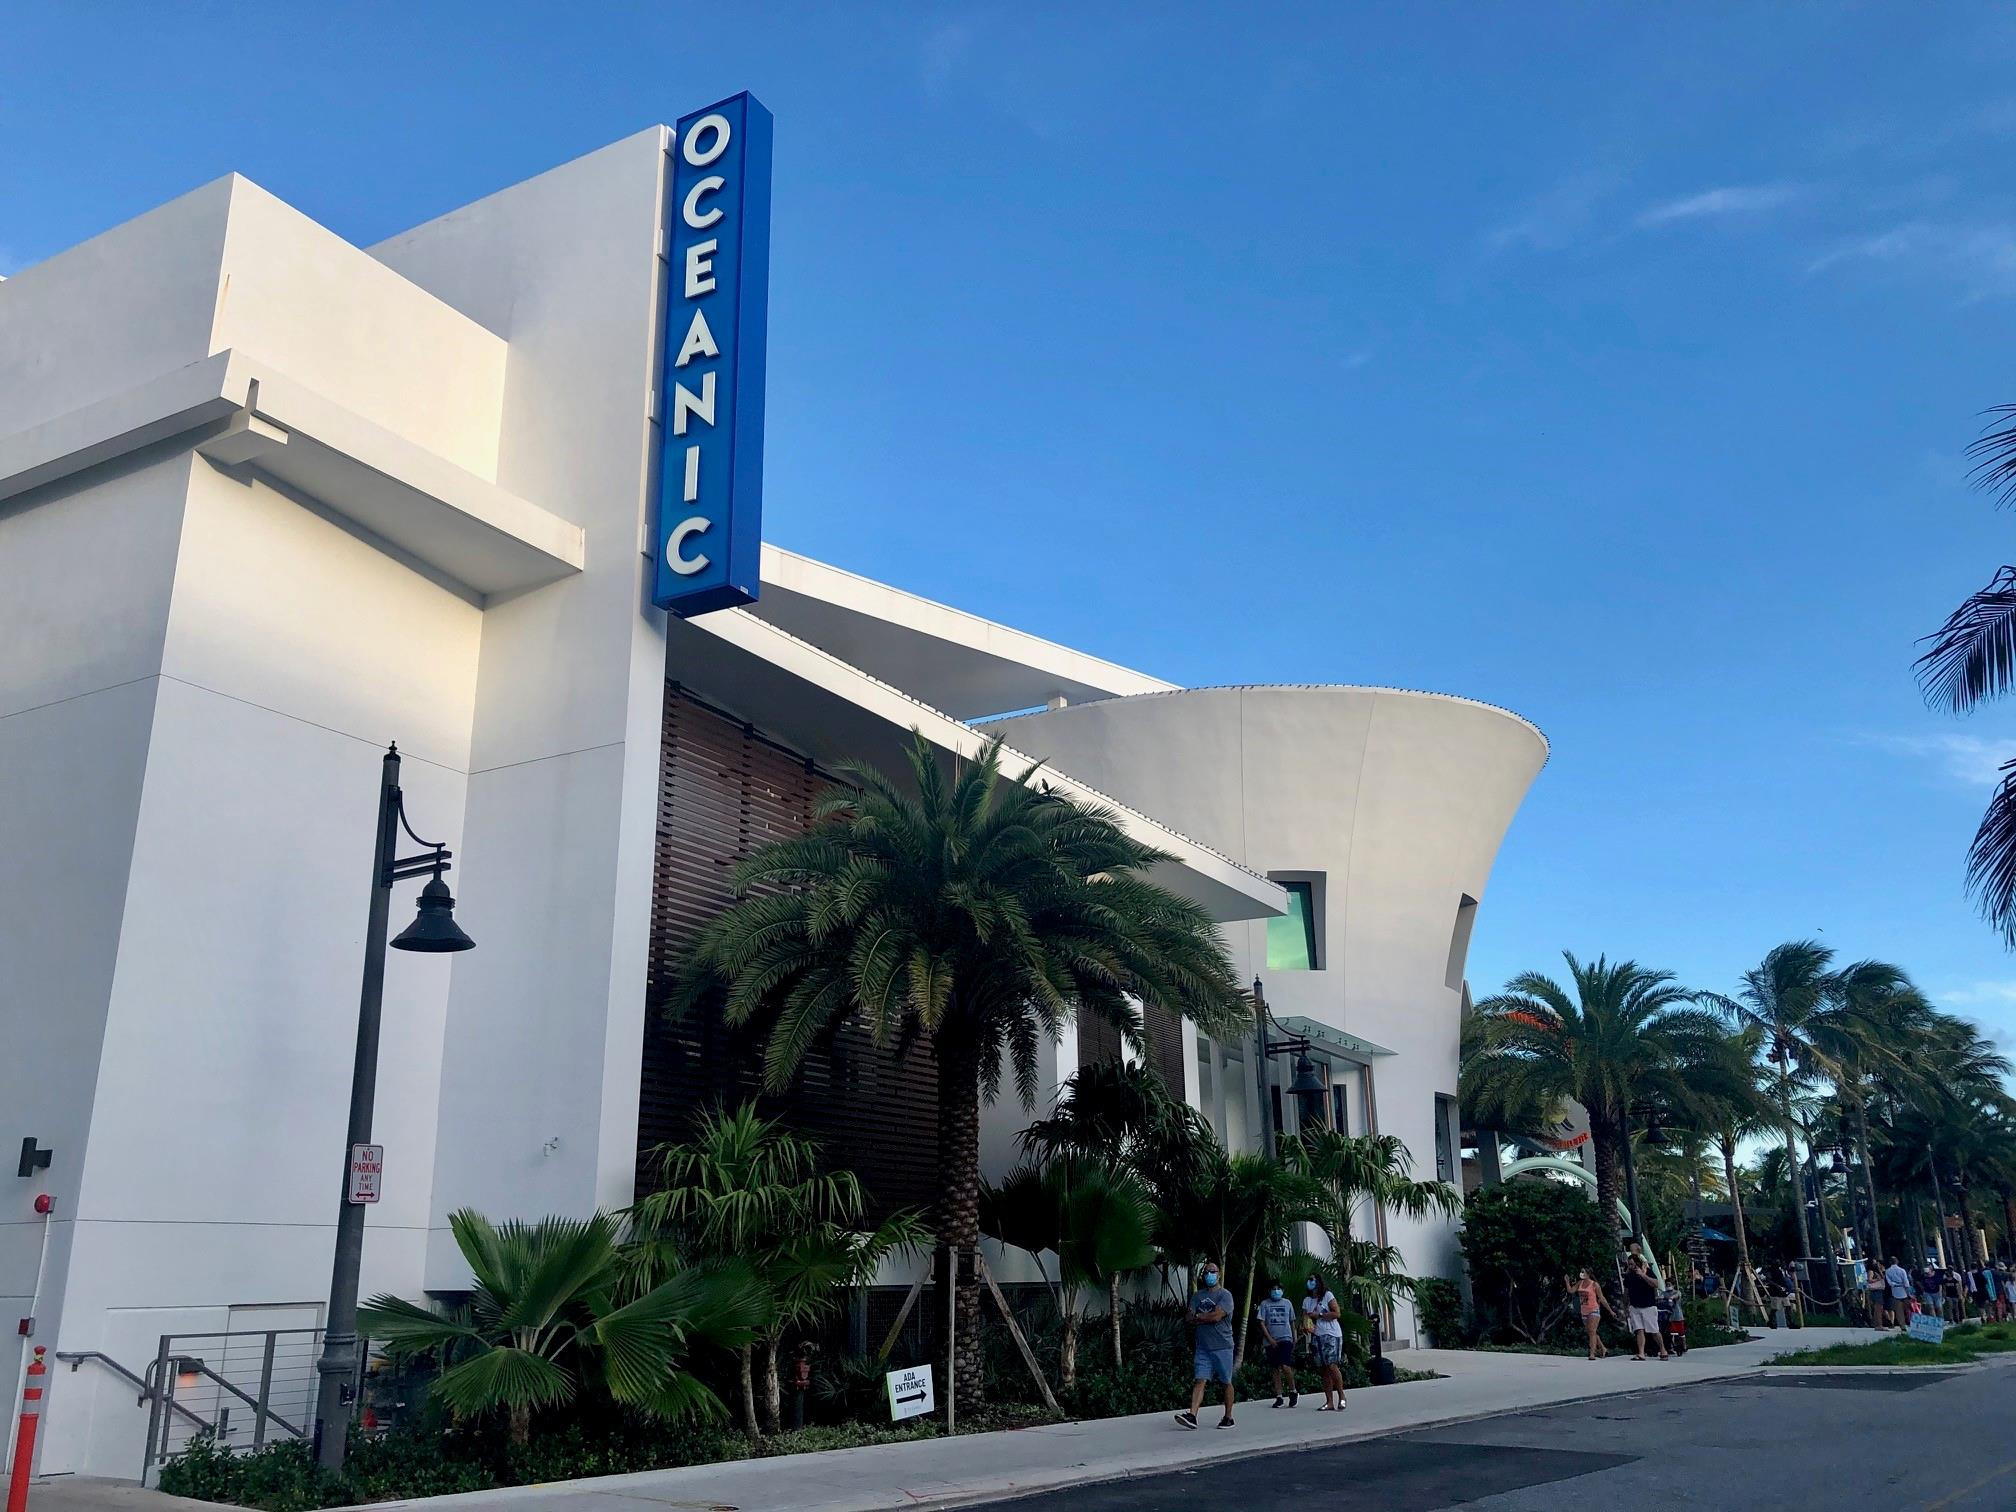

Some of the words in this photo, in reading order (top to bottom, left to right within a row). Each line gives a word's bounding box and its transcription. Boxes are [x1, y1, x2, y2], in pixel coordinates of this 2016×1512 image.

[666, 113, 730, 576] OCEANIC
[362, 1150, 373, 1161] NO
[353, 1162, 380, 1173] PARKING
[361, 1174, 373, 1182] ANY
[359, 1182, 373, 1191] TIME
[903, 1371, 915, 1382] ADA
[895, 1378, 926, 1393] ENTRANCE
